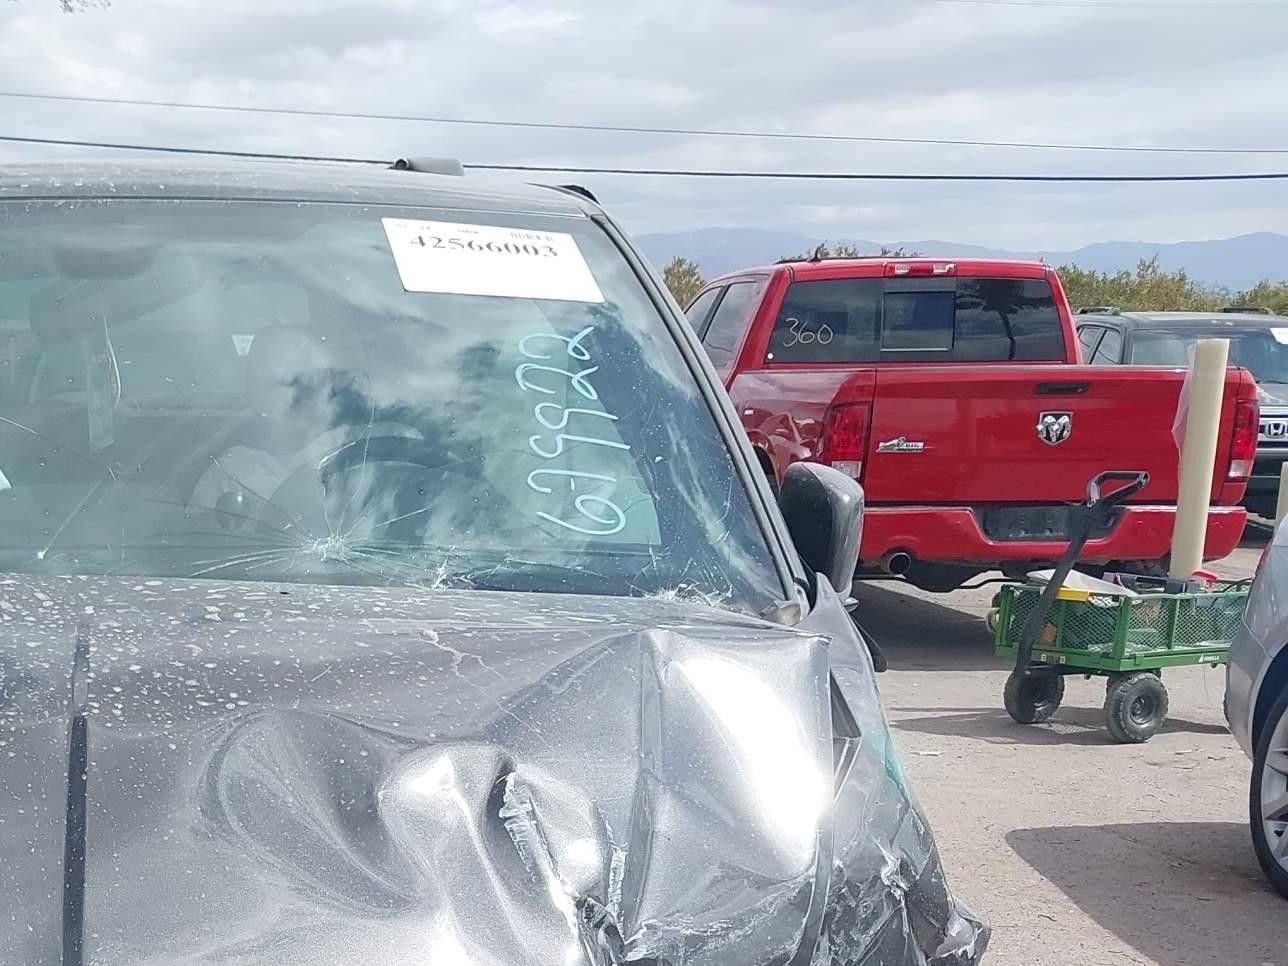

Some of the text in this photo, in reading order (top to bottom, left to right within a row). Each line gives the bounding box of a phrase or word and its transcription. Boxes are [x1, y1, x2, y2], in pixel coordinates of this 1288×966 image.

[410, 235, 558, 257] 42566003
[782, 317, 834, 348] 360
[515, 326, 632, 535] 679922
